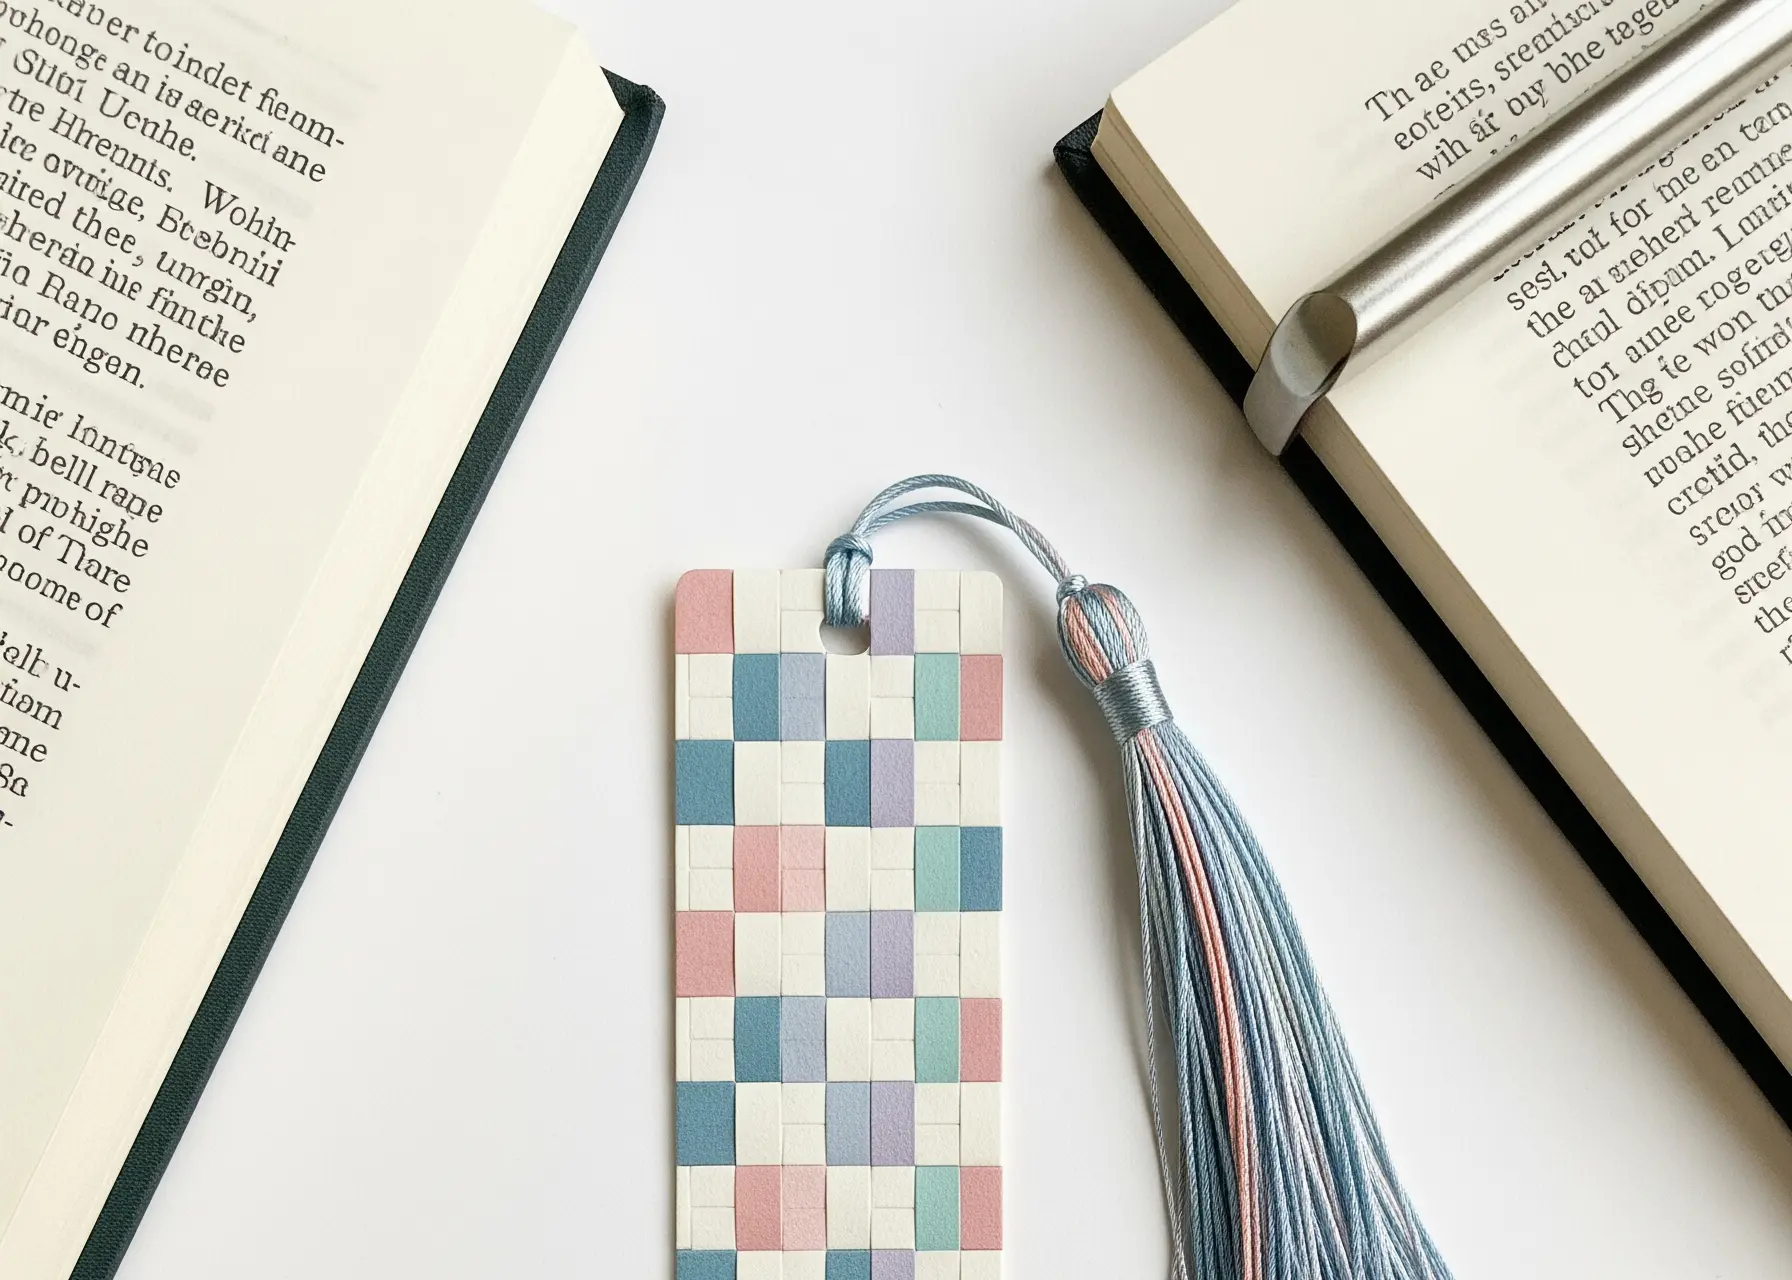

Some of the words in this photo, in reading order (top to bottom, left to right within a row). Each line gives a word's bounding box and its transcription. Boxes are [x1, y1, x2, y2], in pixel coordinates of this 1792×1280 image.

[1610, 198, 1653, 237] for
[1527, 301, 1575, 338] the
[1693, 310, 1757, 356] won
[18, 525, 54, 551] of
[1712, 525, 1762, 580] god
[85, 602, 123, 628] of
